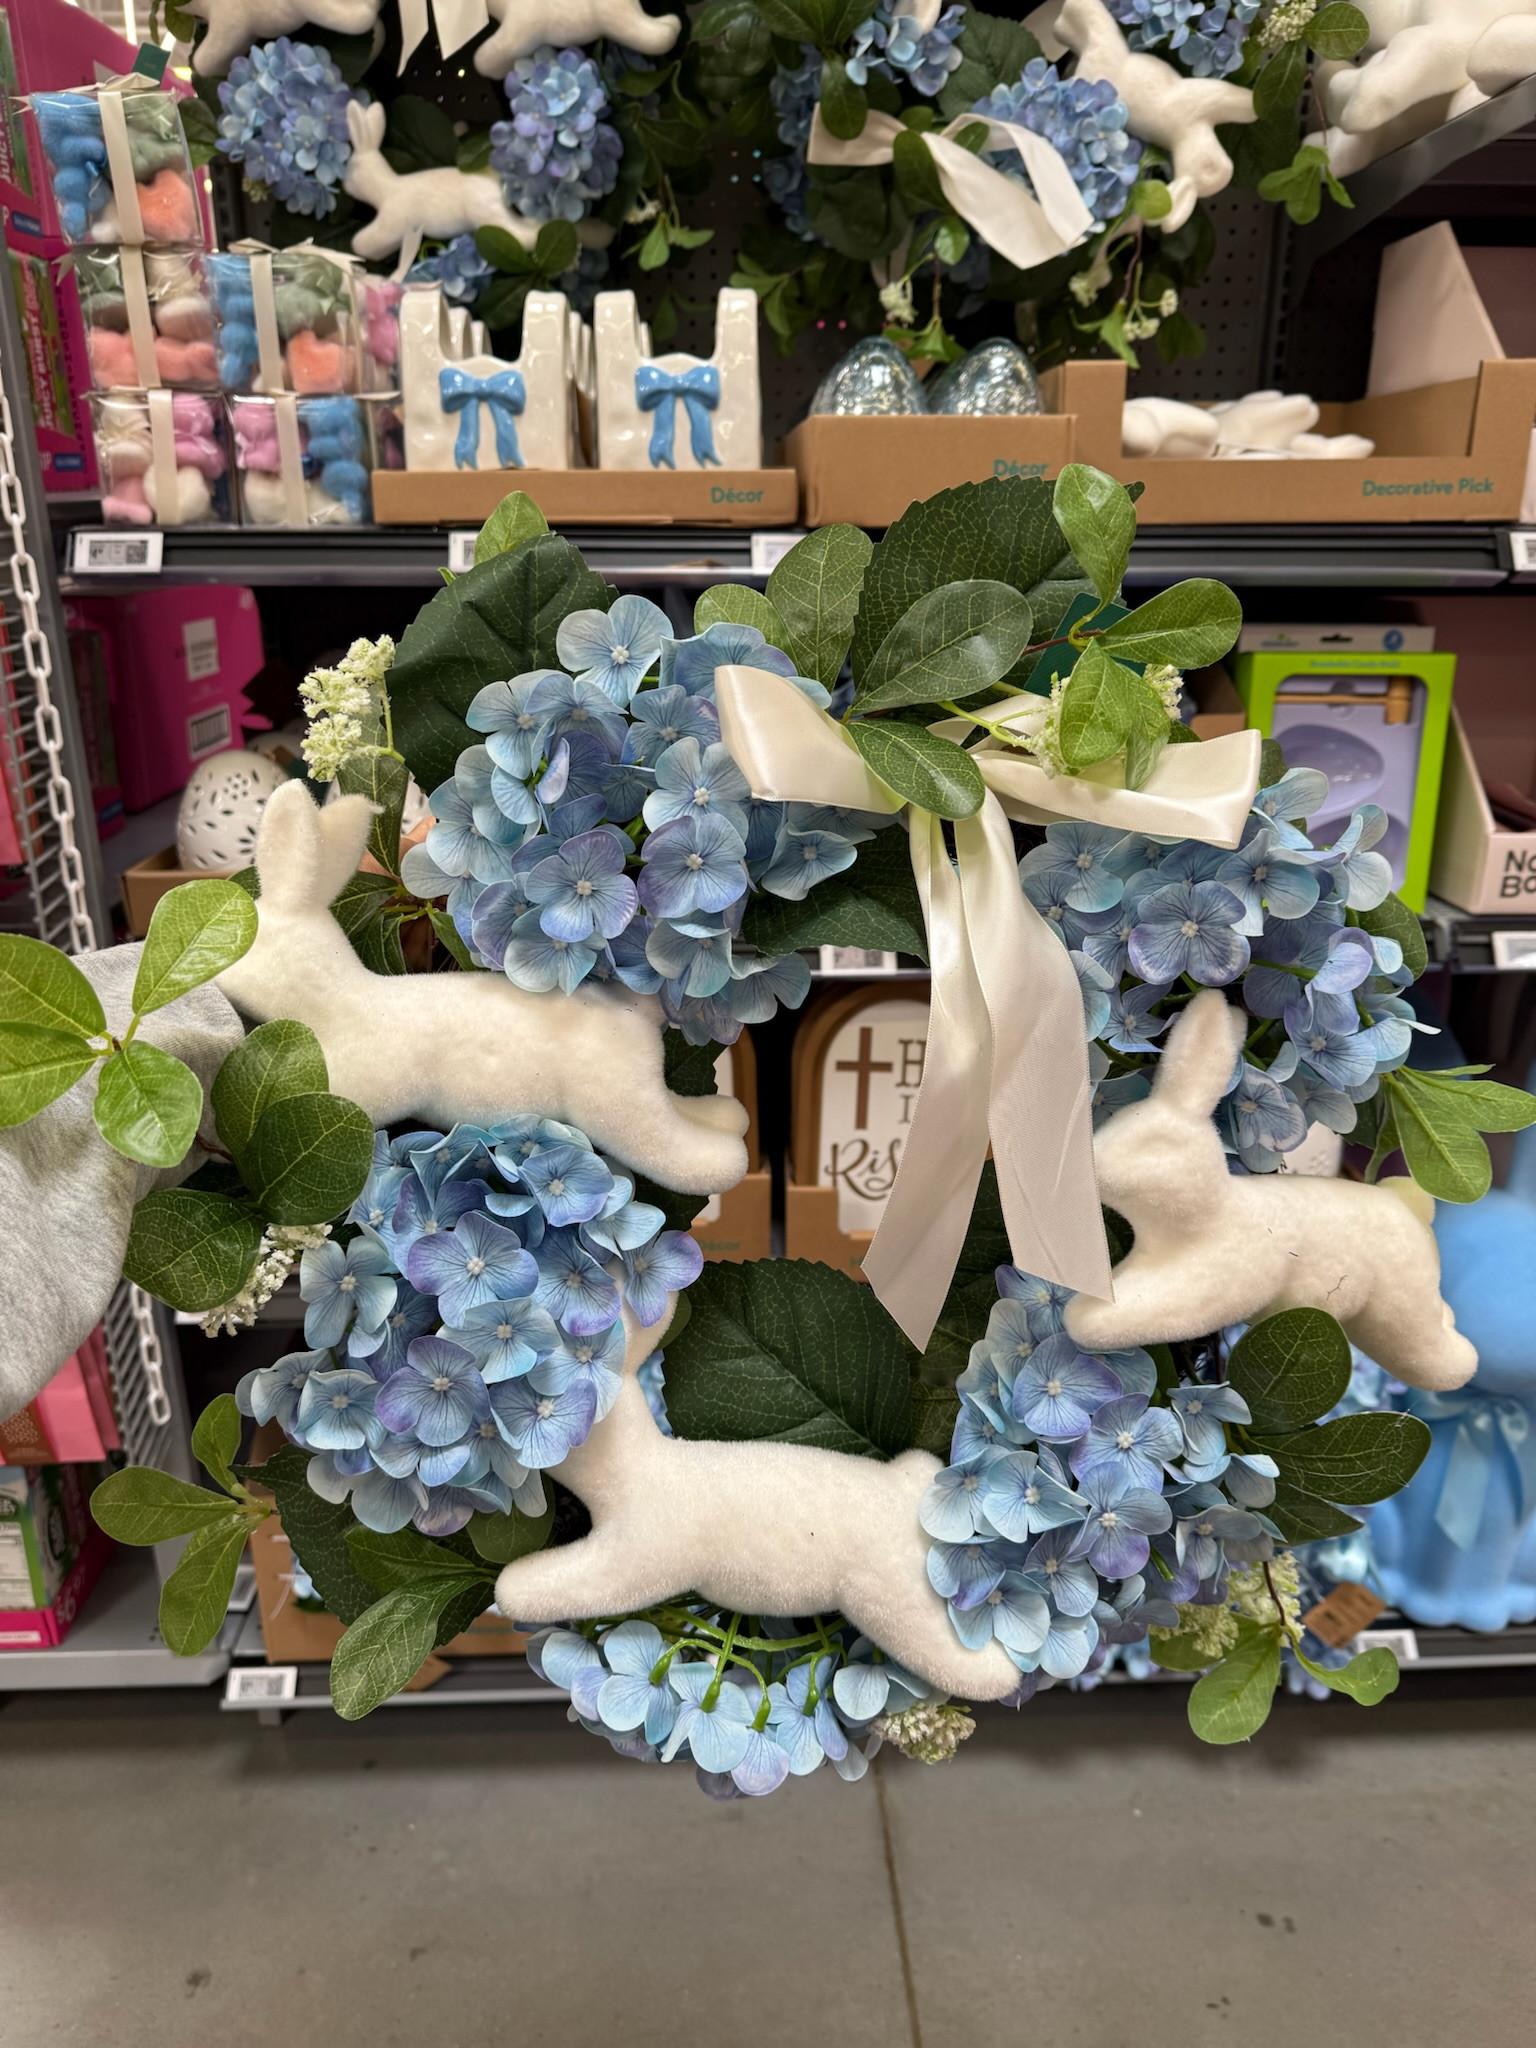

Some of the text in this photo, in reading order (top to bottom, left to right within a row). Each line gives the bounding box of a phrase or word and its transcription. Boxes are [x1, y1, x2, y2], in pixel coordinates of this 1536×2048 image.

[993, 459, 1049, 477] Décor
[710, 486, 764, 504] Décor
[1362, 477, 1493, 496] Decorative Pick
[896, 1039, 927, 1088] H
[899, 1094, 913, 1124] I
[824, 1137, 902, 1201] Ris
